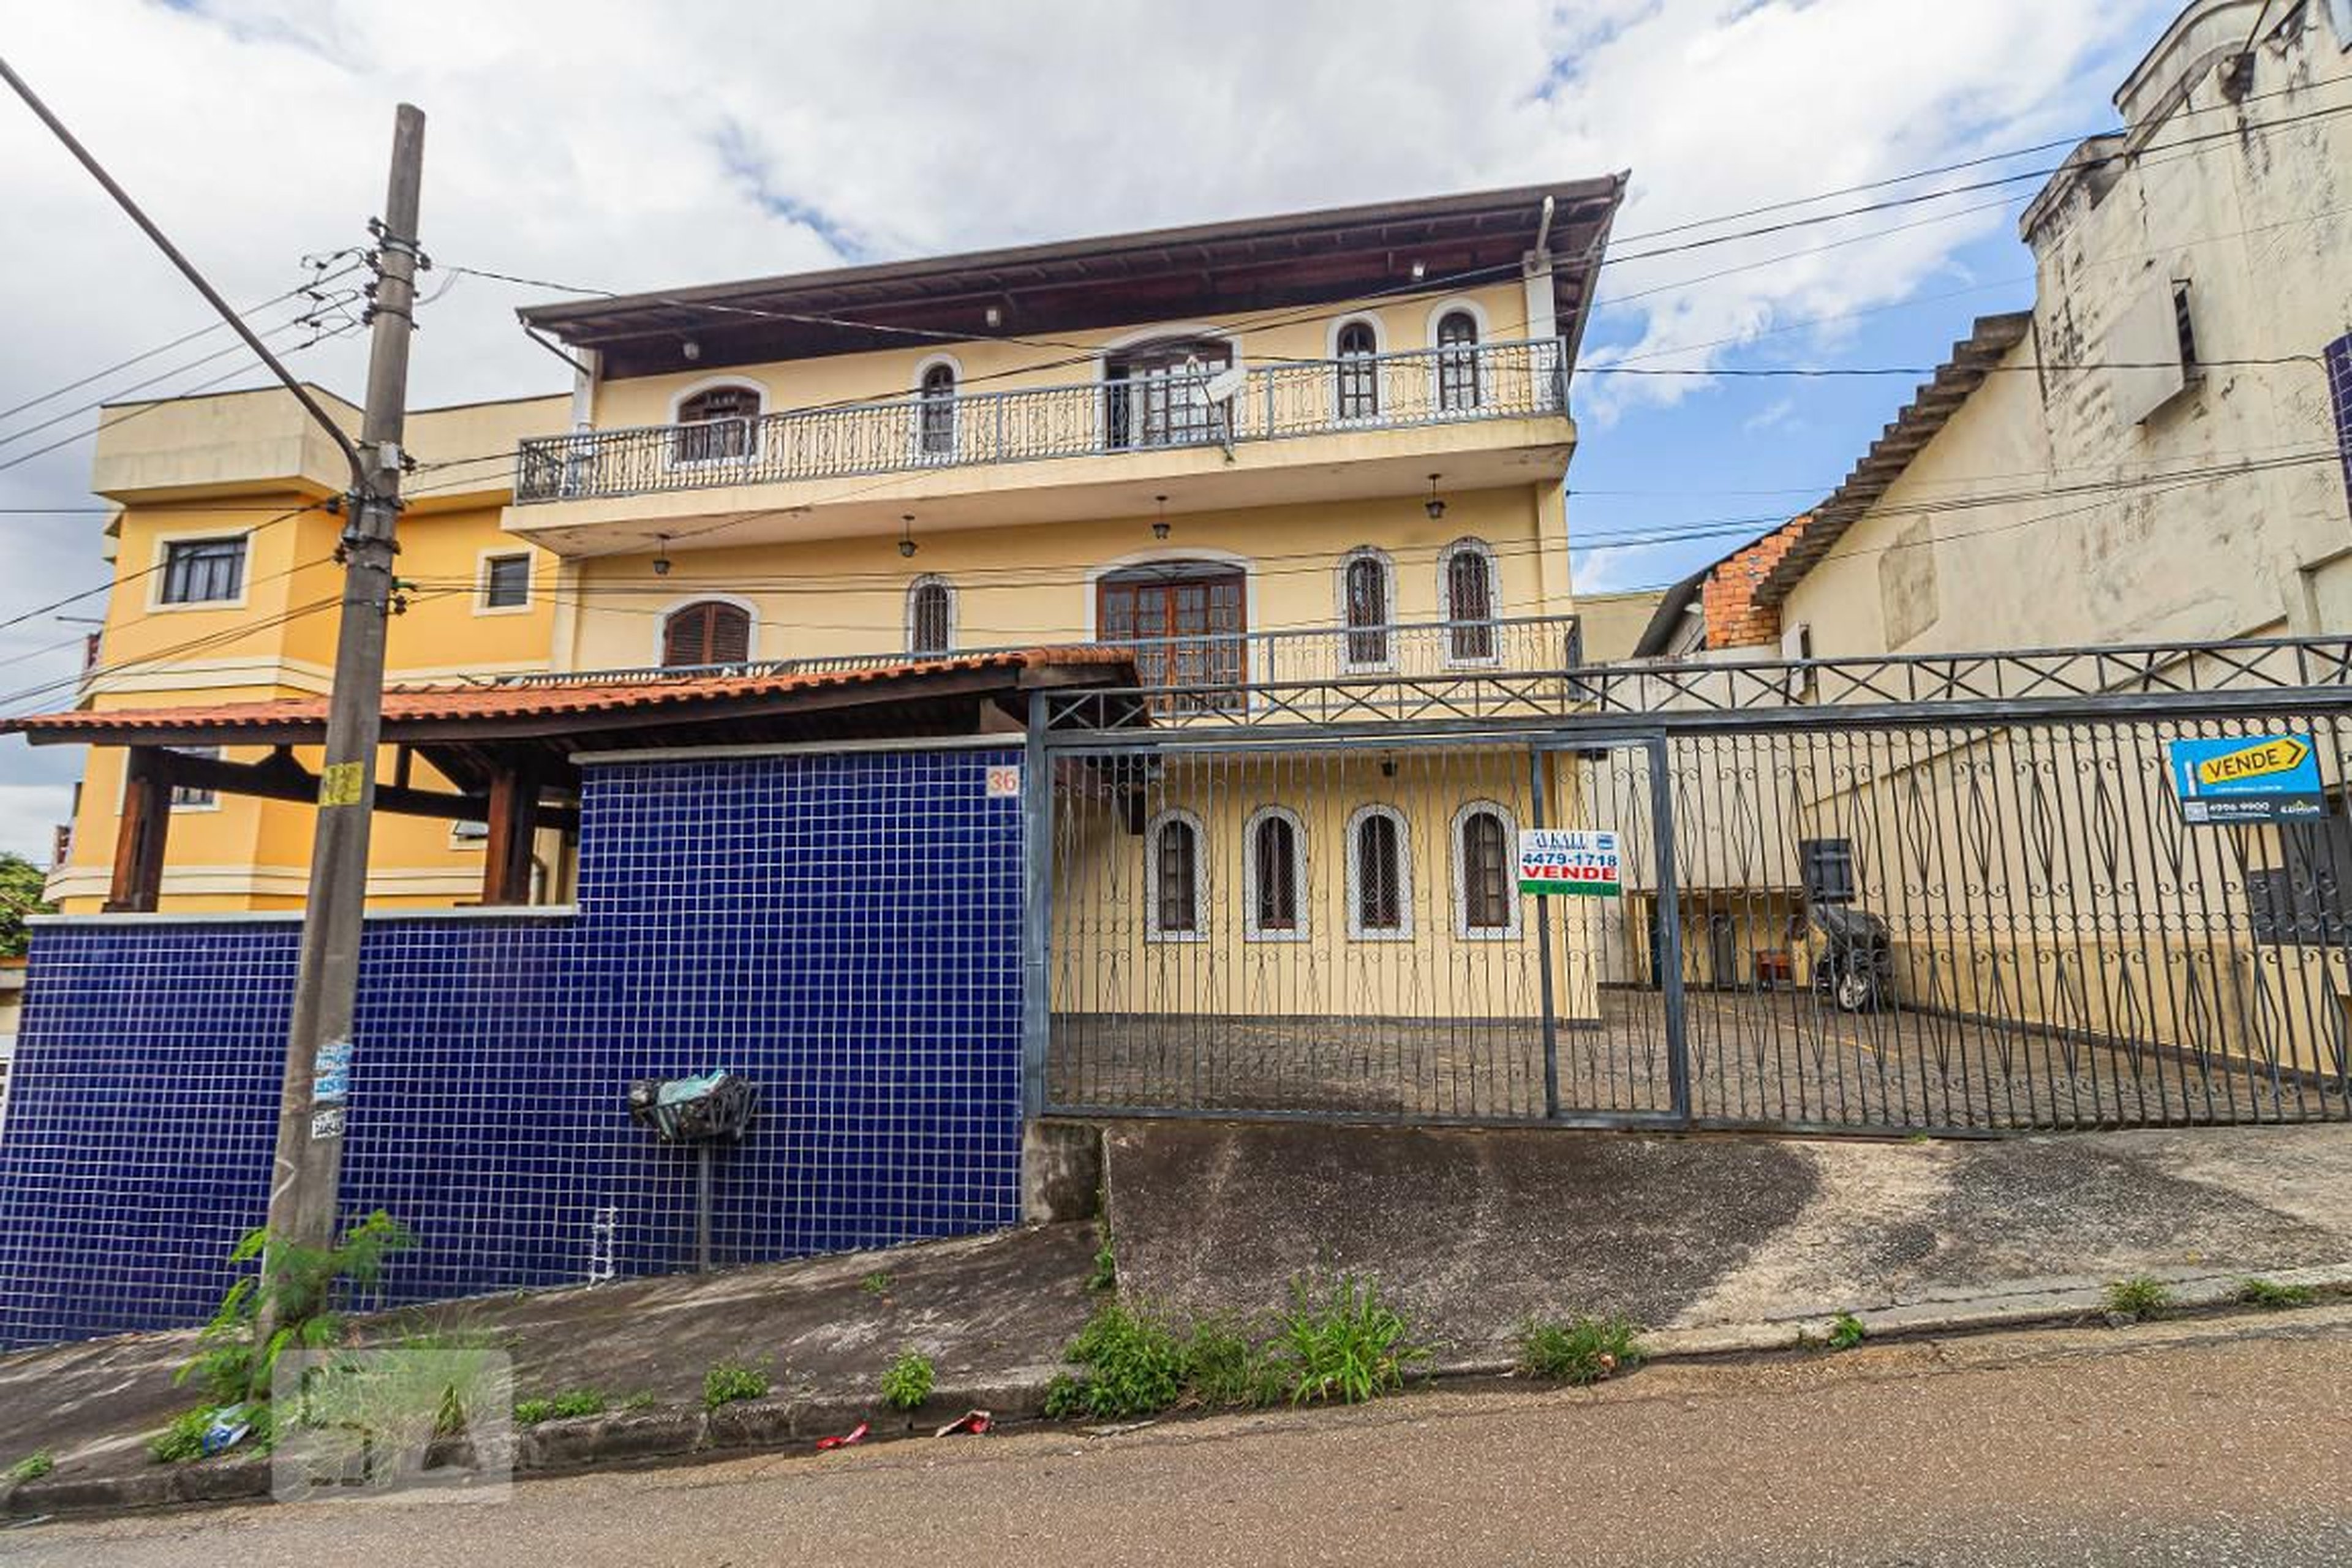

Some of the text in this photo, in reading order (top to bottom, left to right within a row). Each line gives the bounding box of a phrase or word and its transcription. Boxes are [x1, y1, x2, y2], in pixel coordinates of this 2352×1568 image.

[2207, 748, 2280, 778] VENDE
[989, 770, 1017, 791] 36
[1522, 853, 1618, 867] 4479-1718
[1522, 865, 1618, 881] VENDE
